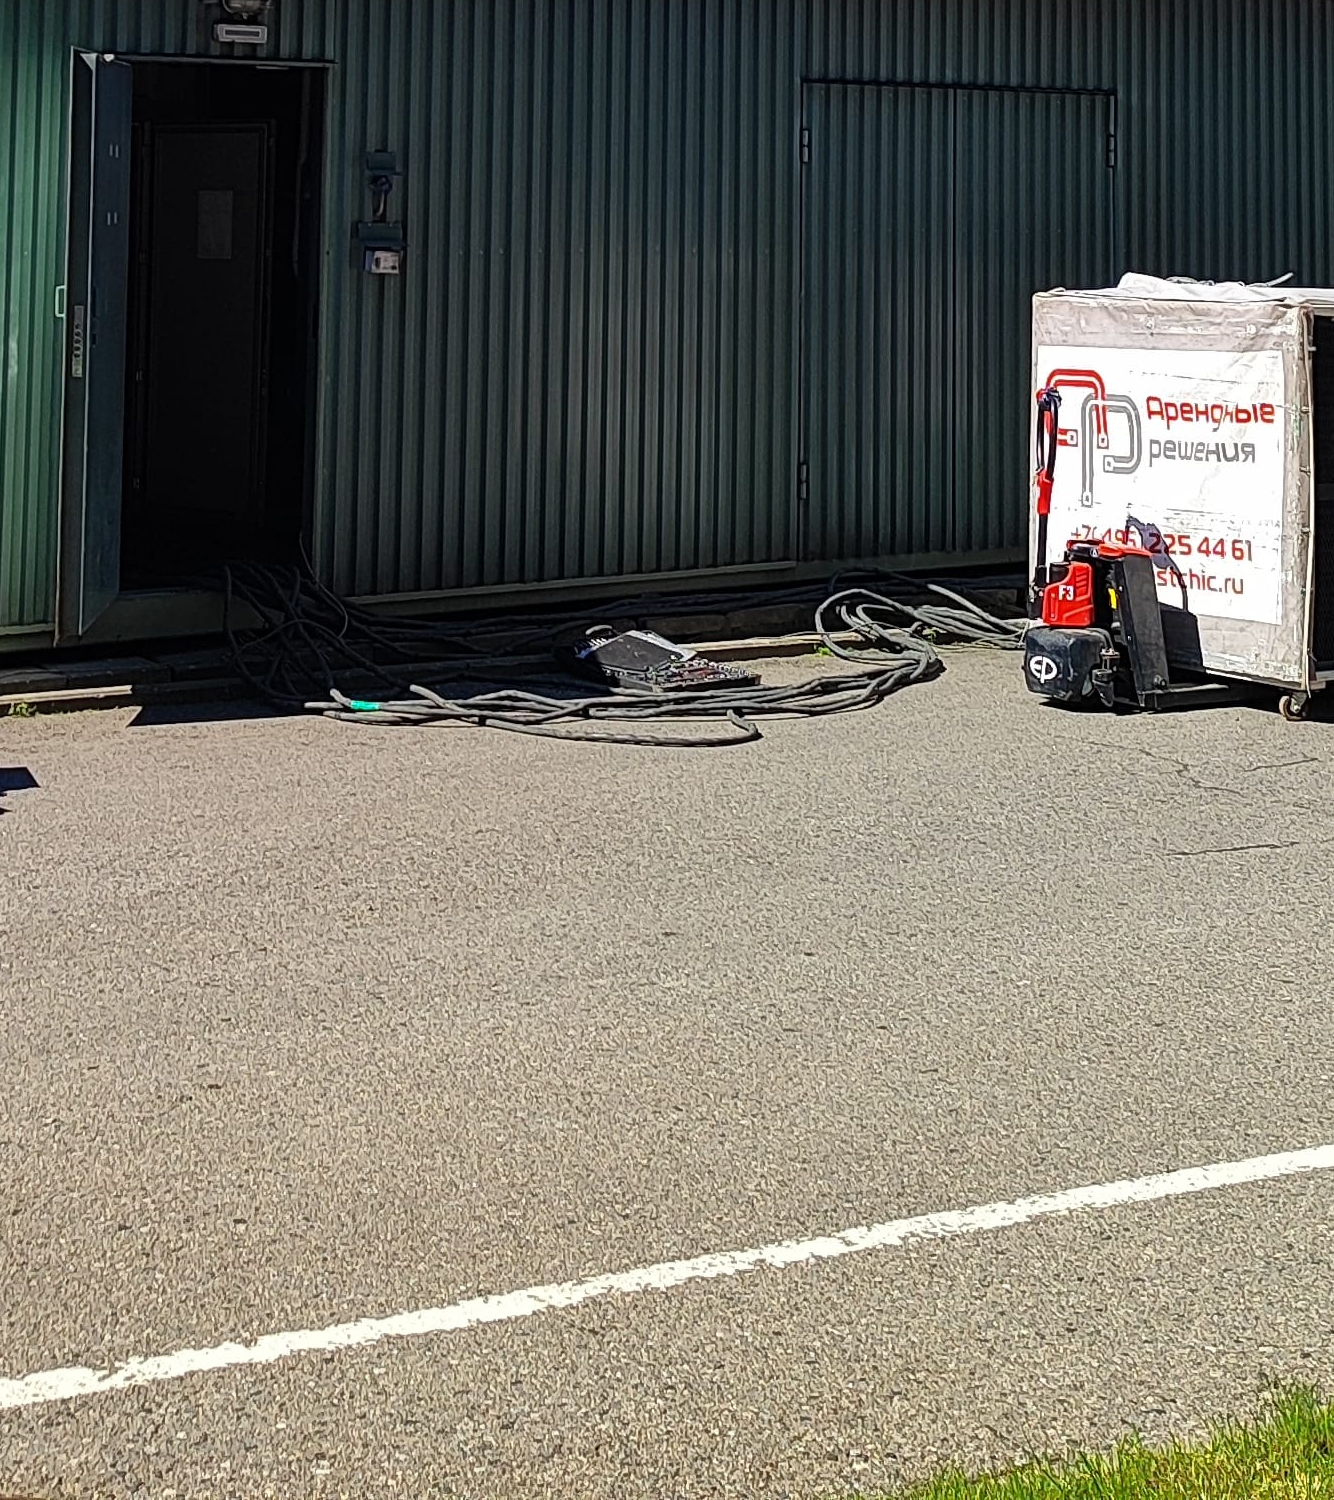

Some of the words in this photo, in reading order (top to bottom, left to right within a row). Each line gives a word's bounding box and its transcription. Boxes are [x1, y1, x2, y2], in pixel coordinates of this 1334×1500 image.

[1146, 396, 1275, 432] Арендные
[1149, 438, 1255, 467] решения
[1148, 532, 1191, 556] 225
[1196, 536, 1226, 558] 44
[1231, 539, 1253, 562] 61
[1156, 567, 1244, 595] stchic.ru
